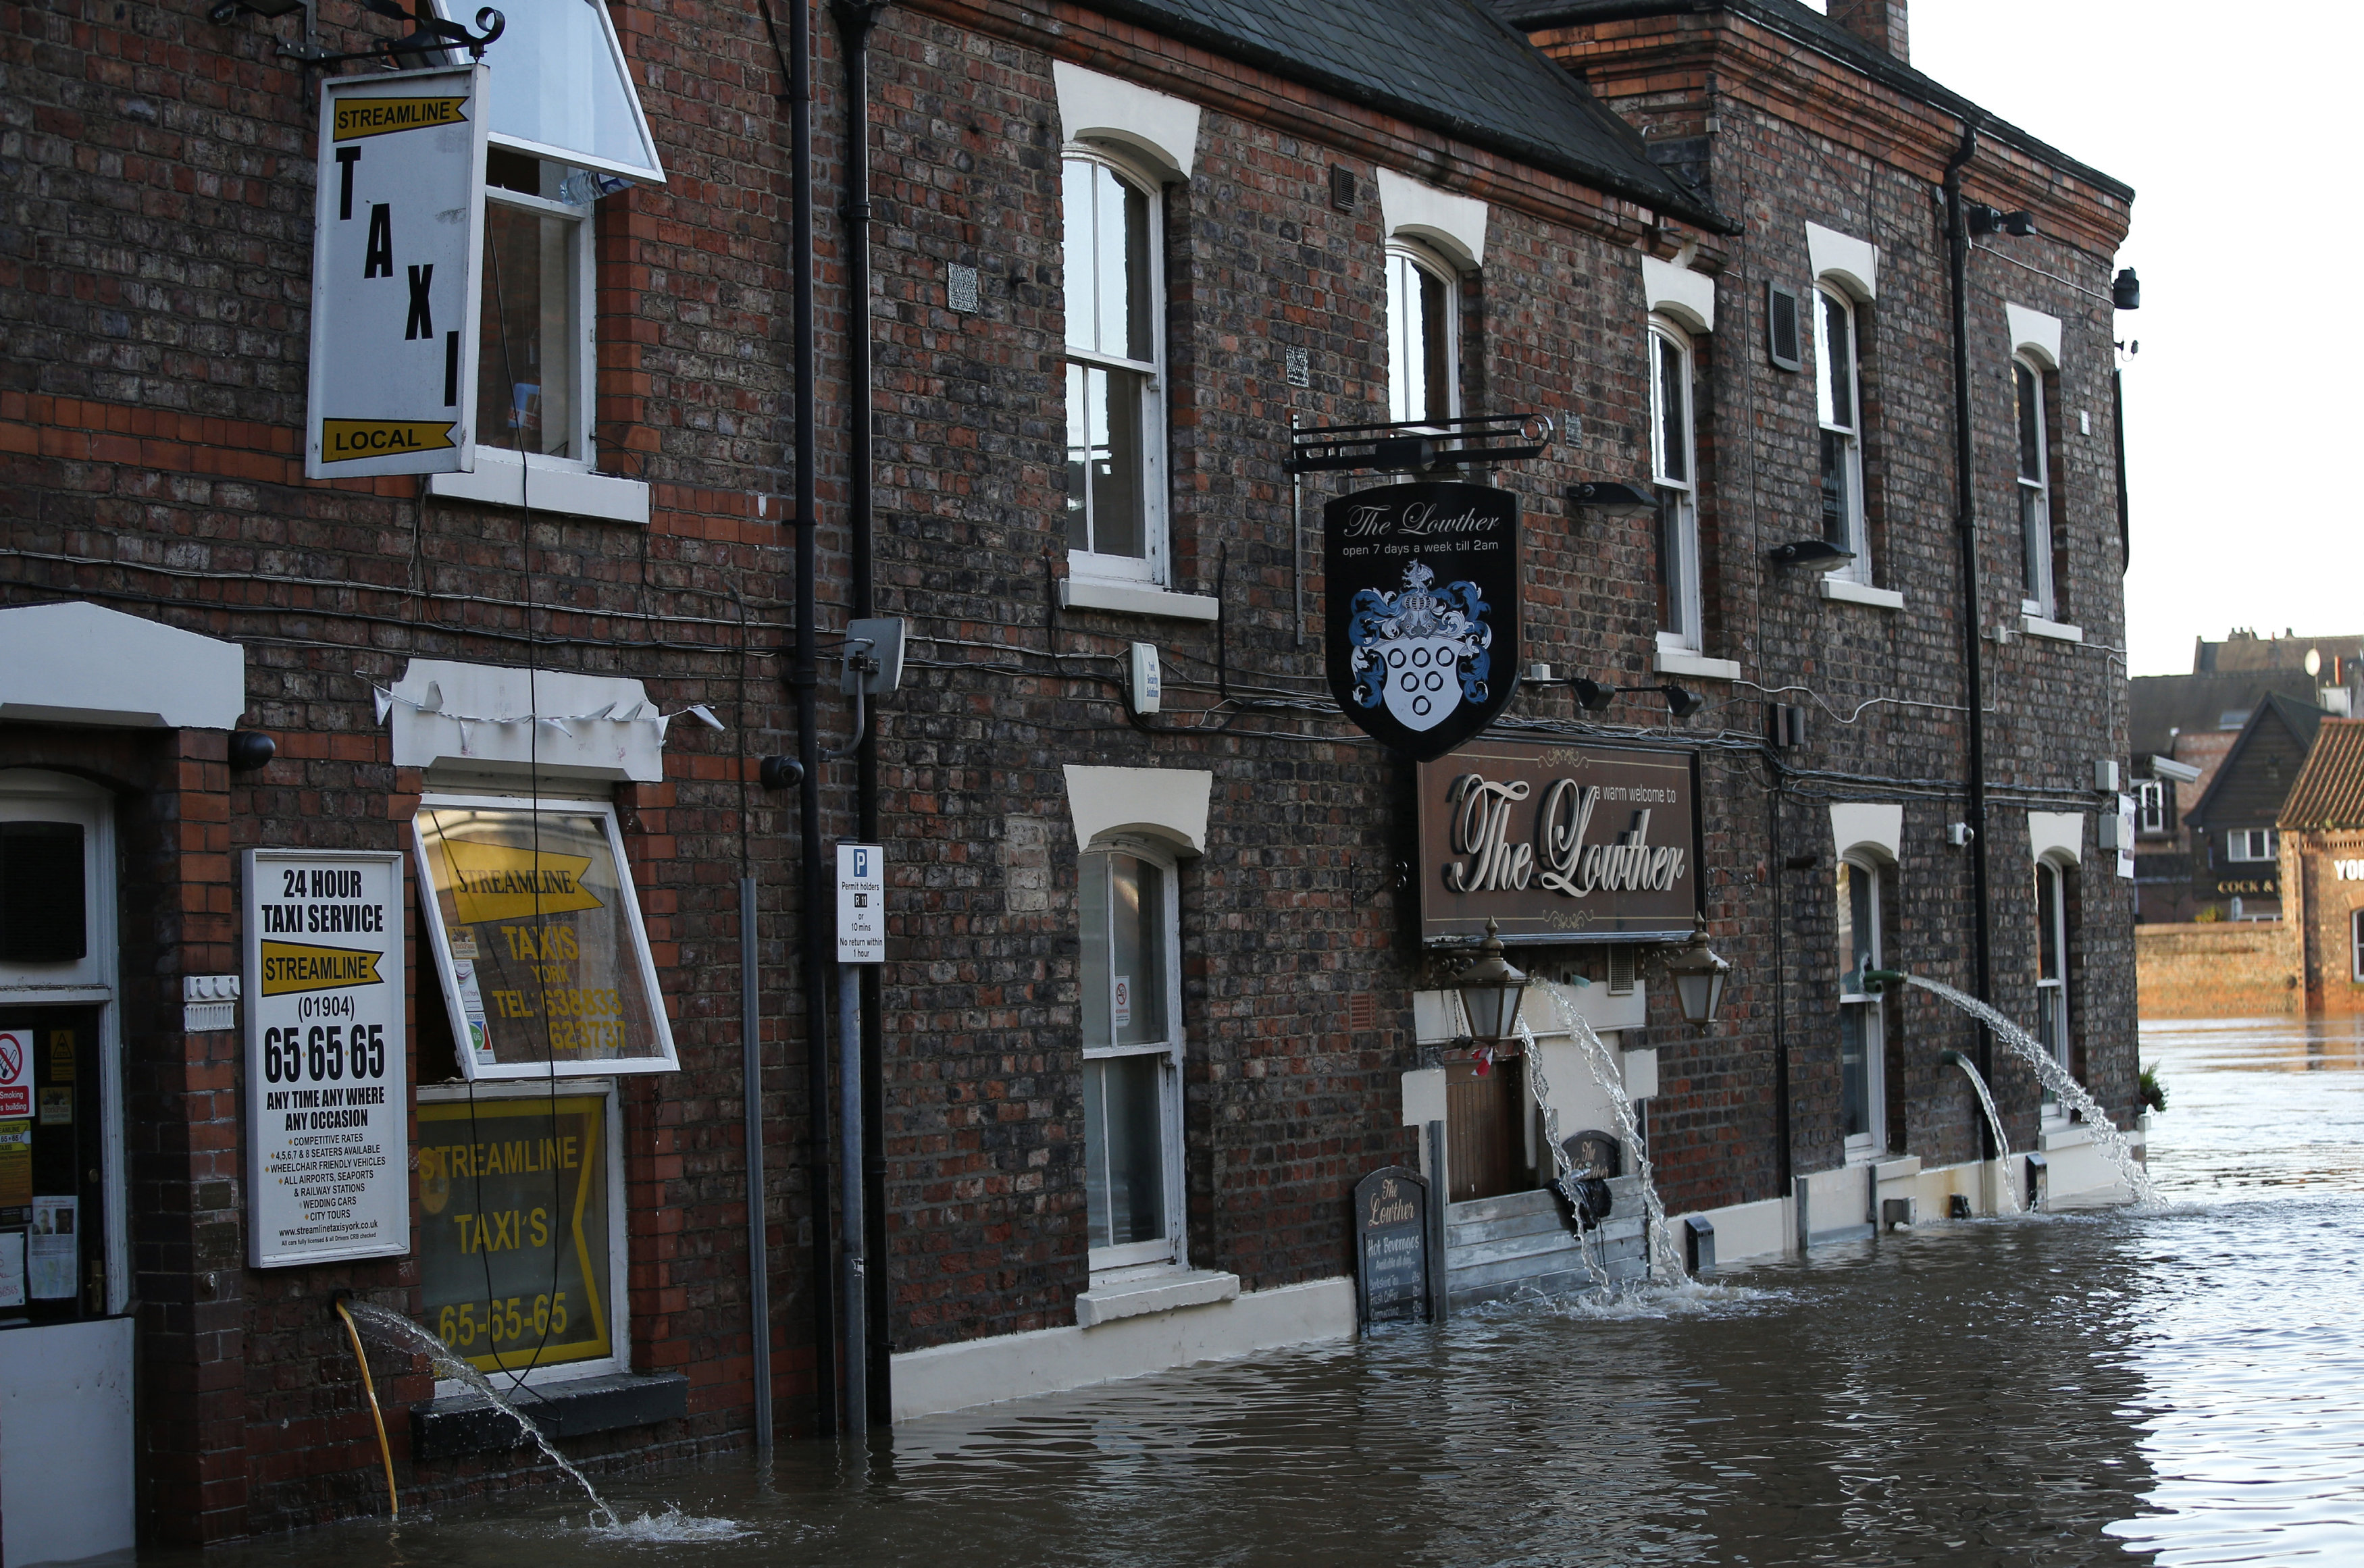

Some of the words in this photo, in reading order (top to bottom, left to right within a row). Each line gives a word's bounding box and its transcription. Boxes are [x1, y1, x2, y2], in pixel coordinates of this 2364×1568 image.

[338, 101, 450, 130] STREAMLINE
[336, 145, 459, 407] TAXI
[336, 429, 421, 451] LOCAL
[1343, 504, 1391, 537] The
[1397, 502, 1500, 535] Lowther
[1343, 546, 1368, 557] open
[1373, 544, 1380, 554] 7
[1385, 544, 1410, 555] days
[1414, 544, 1420, 552] a
[1424, 542, 1451, 552] week
[1456, 540, 1470, 551] till
[1474, 540, 1498, 550] 2am
[1603, 787, 1626, 801] warm
[1628, 783, 1664, 802] welcome
[1666, 787, 1676, 803] to
[1451, 773, 1533, 893] The
[1541, 778, 1685, 897] Lowther
[284, 869, 307, 897] 24
[311, 870, 362, 898] HOUR
[455, 868, 575, 894] STREAMLINE
[842, 881, 859, 890] Permit
[860, 882, 879, 891] holders
[2217, 880, 2259, 894] COCK
[2263, 879, 2275, 893] &
[855, 895, 860, 906] R
[861, 895, 867, 906] 11
[261, 904, 303, 933] TAXI
[308, 904, 384, 933] SERVICE
[852, 922, 858, 931] 10
[858, 923, 871, 931] mins
[501, 925, 580, 962] TAXIS
[840, 937, 848, 945] No
[867, 937, 883, 946] within
[857, 949, 869, 957] hour
[265, 956, 368, 981] STREAMLINE
[530, 965, 570, 983] YORK
[298, 995, 355, 1023] (01904)
[540, 989, 623, 1016] 638833
[549, 1020, 626, 1050] 623737
[5, 1102, 27, 1112] building
[267, 1091, 290, 1110] ANY
[292, 1090, 319, 1109] TIME
[322, 1089, 344, 1107] ANY
[346, 1087, 384, 1105] WHERE
[285, 1112, 308, 1131] ANY
[310, 1109, 368, 1130] OCCASION
[294, 1134, 340, 1146] COMPETITIVE
[341, 1133, 363, 1143] RATES
[276, 1150, 297, 1161] 4,5,6,7
[299, 1150, 304, 1158] &
[305, 1149, 309, 1158] 8
[311, 1147, 342, 1157] SEATERS
[344, 1144, 380, 1155] AVAILABLE
[419, 1136, 578, 1180] STREAMLINE
[270, 1161, 317, 1173] WHEELCHAIR
[319, 1159, 352, 1170] FRIENDLY
[353, 1156, 386, 1167] VEHICLES
[284, 1176, 298, 1185] ALL
[299, 1173, 336, 1184] AIRPORTS,
[337, 1170, 374, 1181] SEAPORTS
[294, 1188, 299, 1197] &
[301, 1186, 331, 1197] RAILWAY
[332, 1183, 365, 1194] STATIONS
[1382, 1178, 1398, 1200] The
[303, 1198, 336, 1209] WEDDING
[338, 1196, 357, 1205] CARS
[1368, 1193, 1415, 1227] Lowther
[310, 1211, 326, 1221] CITY
[327, 1209, 351, 1220] TOURS
[279, 1220, 378, 1236] www.streamlinetaxisyork.co.uk
[454, 1207, 548, 1255] TAXI'S
[1368, 1239, 1381, 1257] Hot
[1383, 1235, 1420, 1254] Beverages
[1370, 1292, 1383, 1305] Fresh
[1384, 1288, 1399, 1303] Coffee
[439, 1292, 567, 1349] 65-65-65
